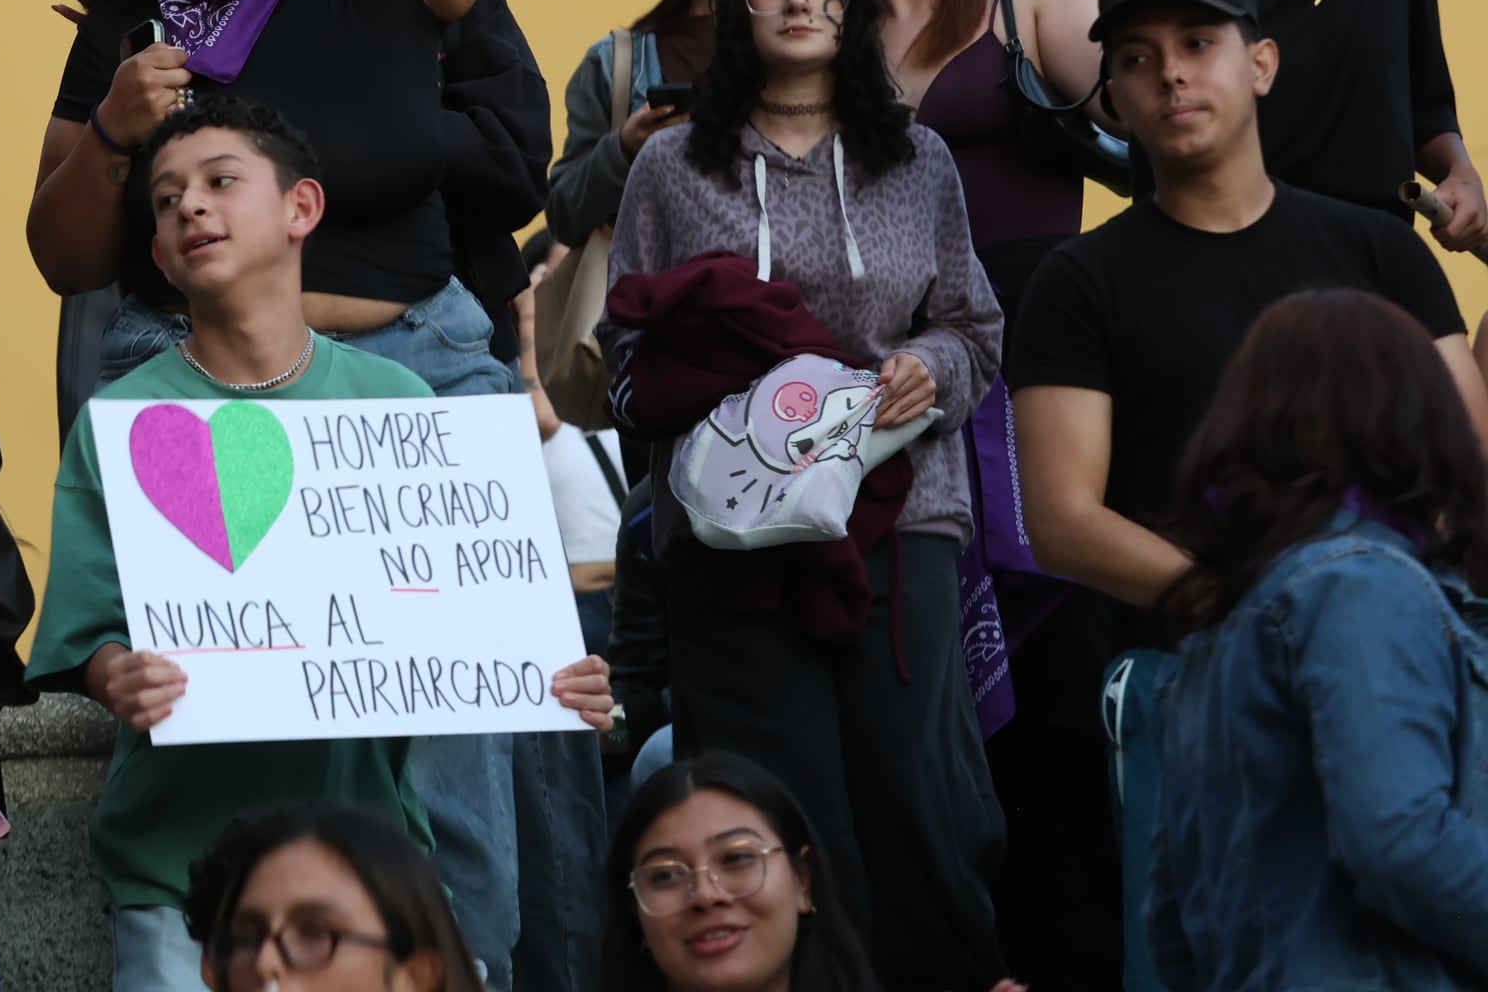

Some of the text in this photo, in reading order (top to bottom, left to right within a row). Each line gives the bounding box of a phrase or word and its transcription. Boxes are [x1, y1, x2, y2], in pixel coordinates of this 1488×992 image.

[304, 410, 461, 471] HOMBRE
[301, 479, 510, 537] BIEN CRIADO
[380, 538, 547, 586] NO APOYA
[144, 593, 383, 649] NUNCA AL
[302, 656, 545, 720] PATRIARCADO
